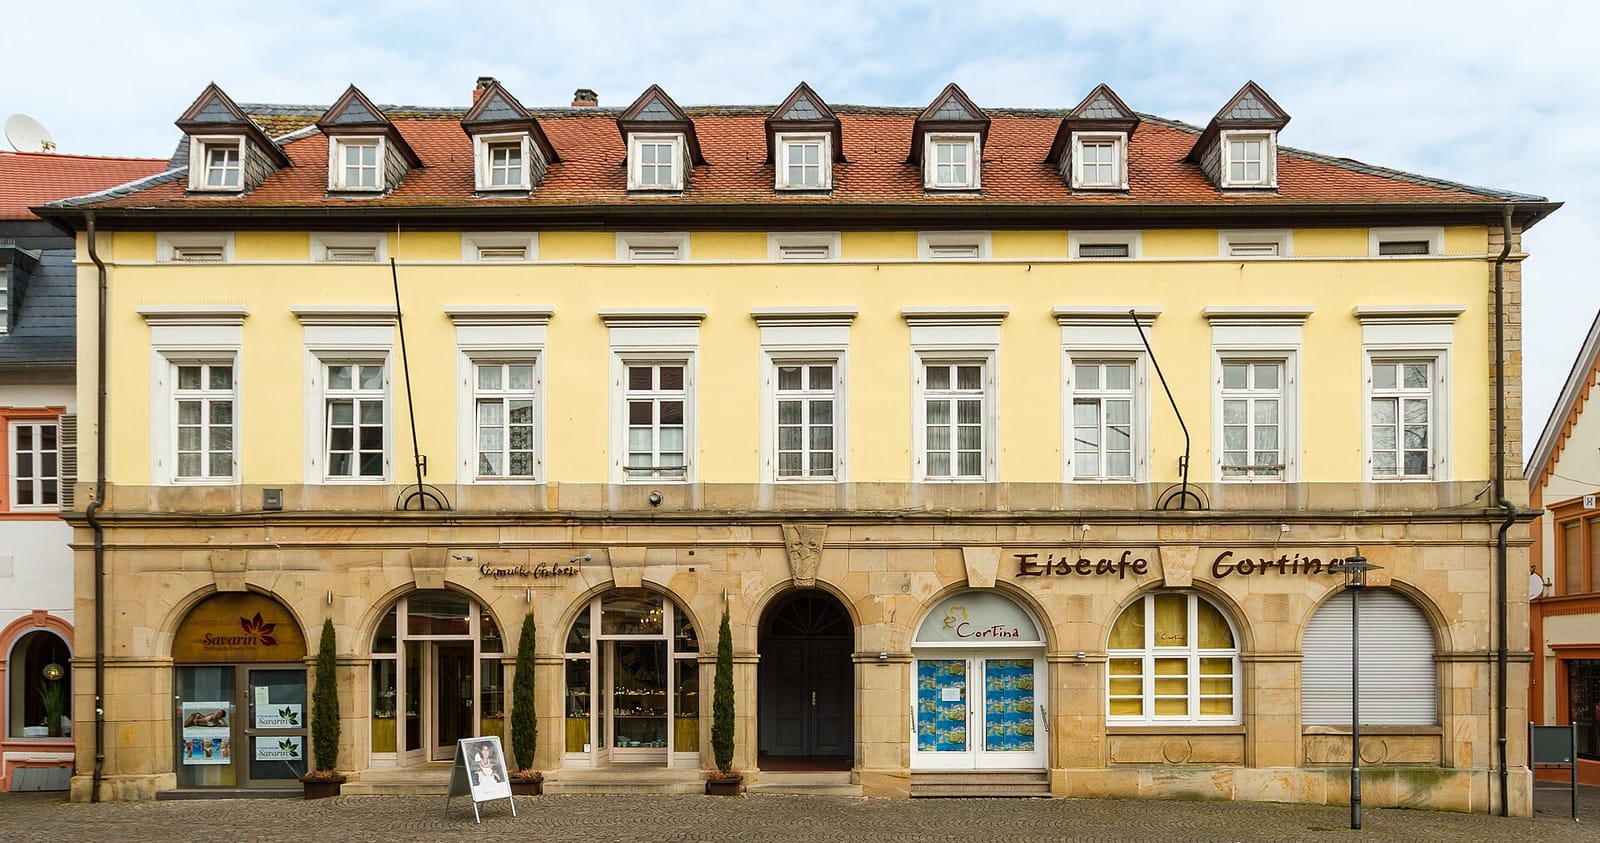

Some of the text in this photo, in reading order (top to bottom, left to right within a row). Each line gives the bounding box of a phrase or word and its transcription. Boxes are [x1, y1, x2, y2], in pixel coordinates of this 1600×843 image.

[1211, 550, 1344, 579] Cortina
[956, 622, 1019, 638] Cortina
[203, 632, 257, 646] Savarin
[258, 718, 288, 726] Savarin
[258, 750, 288, 758] Savarin
